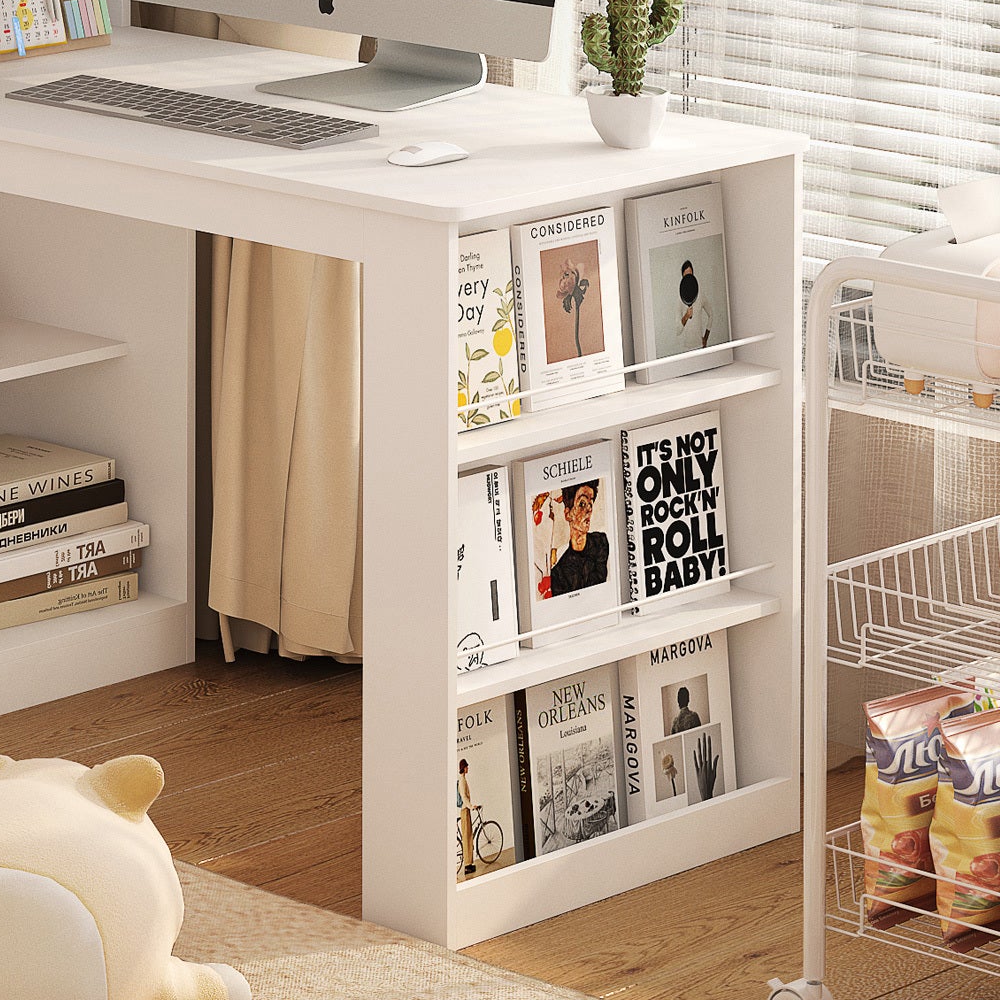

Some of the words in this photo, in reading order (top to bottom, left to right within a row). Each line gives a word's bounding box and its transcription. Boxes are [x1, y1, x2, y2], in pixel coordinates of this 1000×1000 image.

[530, 214, 605, 239] CONSIDERED
[663, 210, 705, 228] KINFOLK
[460, 252, 480, 262] Darling
[466, 263, 483, 272] Thyme
[514, 265, 527, 374] CONSIDERED
[637, 439, 672, 467] IT'S
[675, 427, 718, 457] NOT
[28, 469, 94, 495] WINES
[543, 455, 592, 480] SCHIELE
[637, 449, 719, 503] ONLY
[642, 514, 723, 567] ROLL
[644, 547, 727, 598] BABY!
[650, 634, 713, 666] MARGOVA
[552, 681, 586, 707] NEW
[457, 709, 493, 732] FOLK
[538, 693, 606, 729] ORLEANS
[516, 709, 525, 764] ORLEANS
[559, 724, 587, 739] Louisiana
[622, 695, 641, 796] MARGOVA
